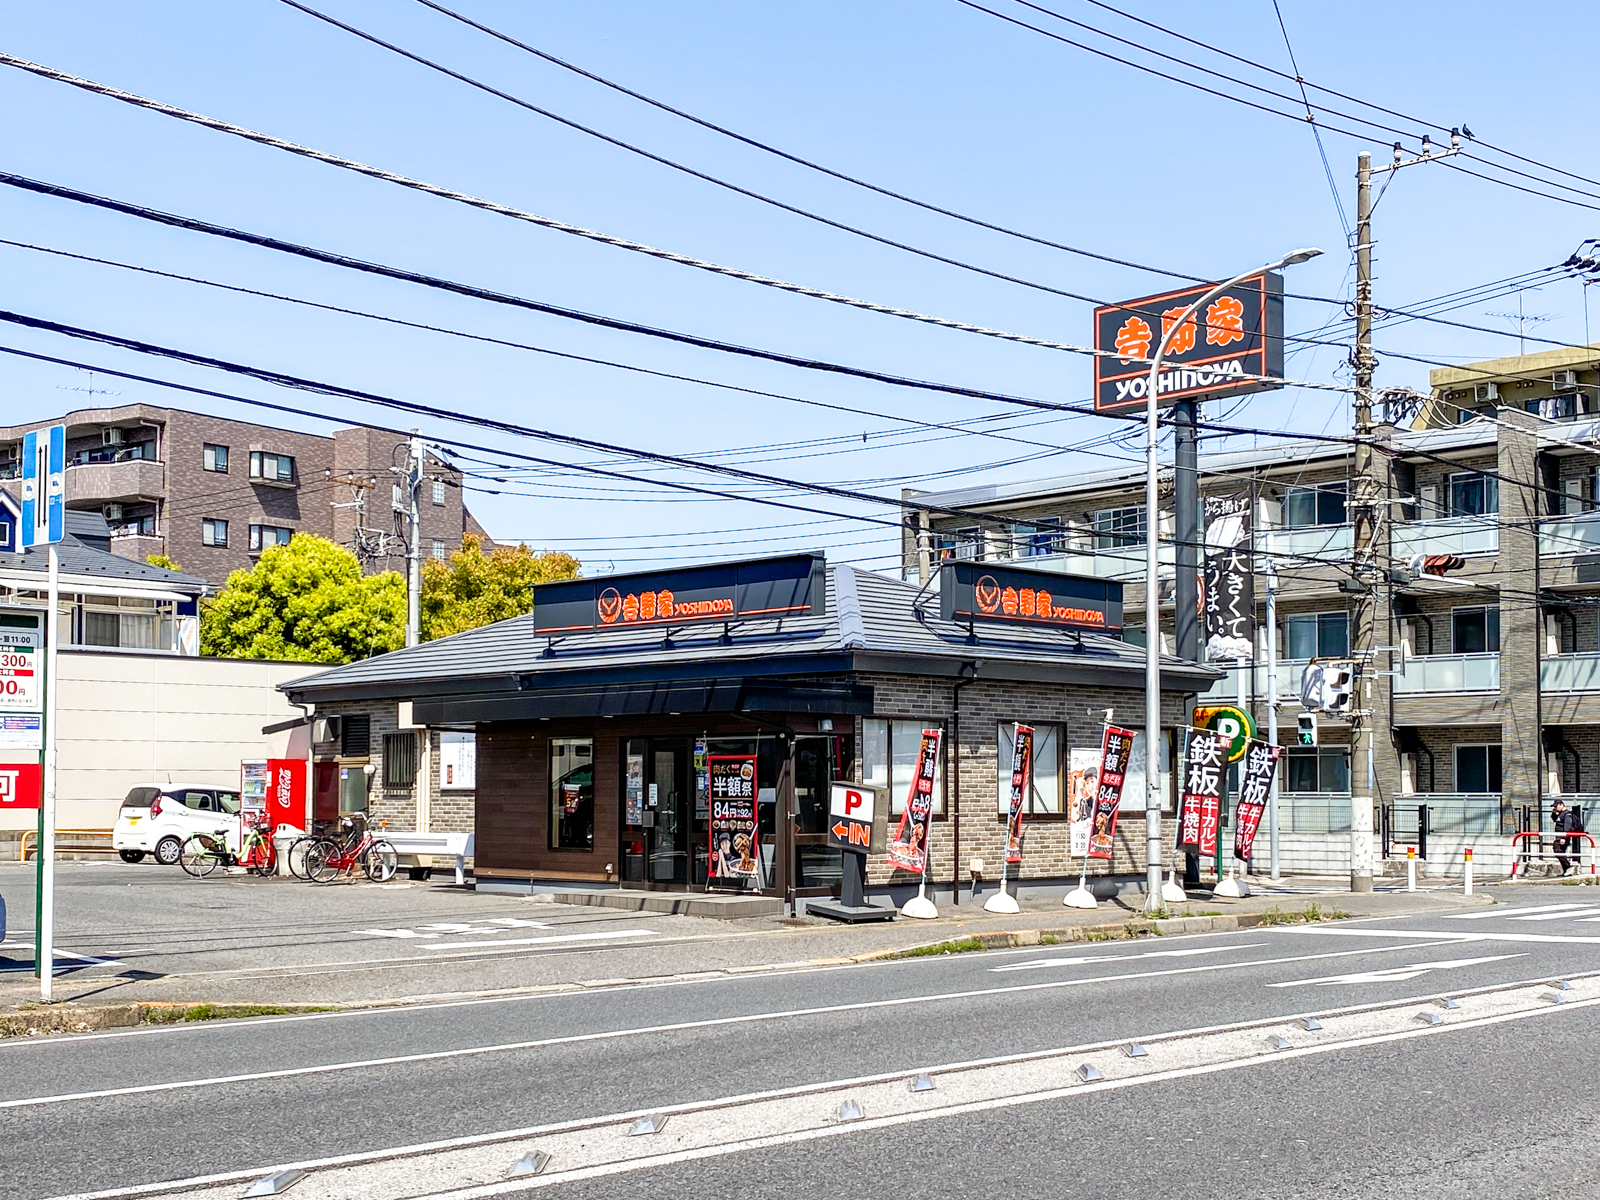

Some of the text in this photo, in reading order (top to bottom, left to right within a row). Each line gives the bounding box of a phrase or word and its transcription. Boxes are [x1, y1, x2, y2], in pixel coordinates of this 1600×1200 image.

[1204, 497, 1249, 517] から揚げ
[1222, 549, 1249, 637] 大きくて
[1104, 735, 1121, 771] 半額
[1119, 738, 1131, 773] 肉だく
[1188, 735, 1222, 797] 鉄板
[713, 776, 752, 797] 半額祭
[1244, 746, 1273, 805] 鉄板
[714, 801, 737, 818] 84円
[845, 790, 862, 815] P
[1098, 785, 1119, 804] 84円
[849, 822, 870, 847] IN
[1182, 796, 1200, 842] 牛焼肉
[1200, 798, 1218, 853] 牛カルビ
[1243, 806, 1260, 859] 牛カルビ
